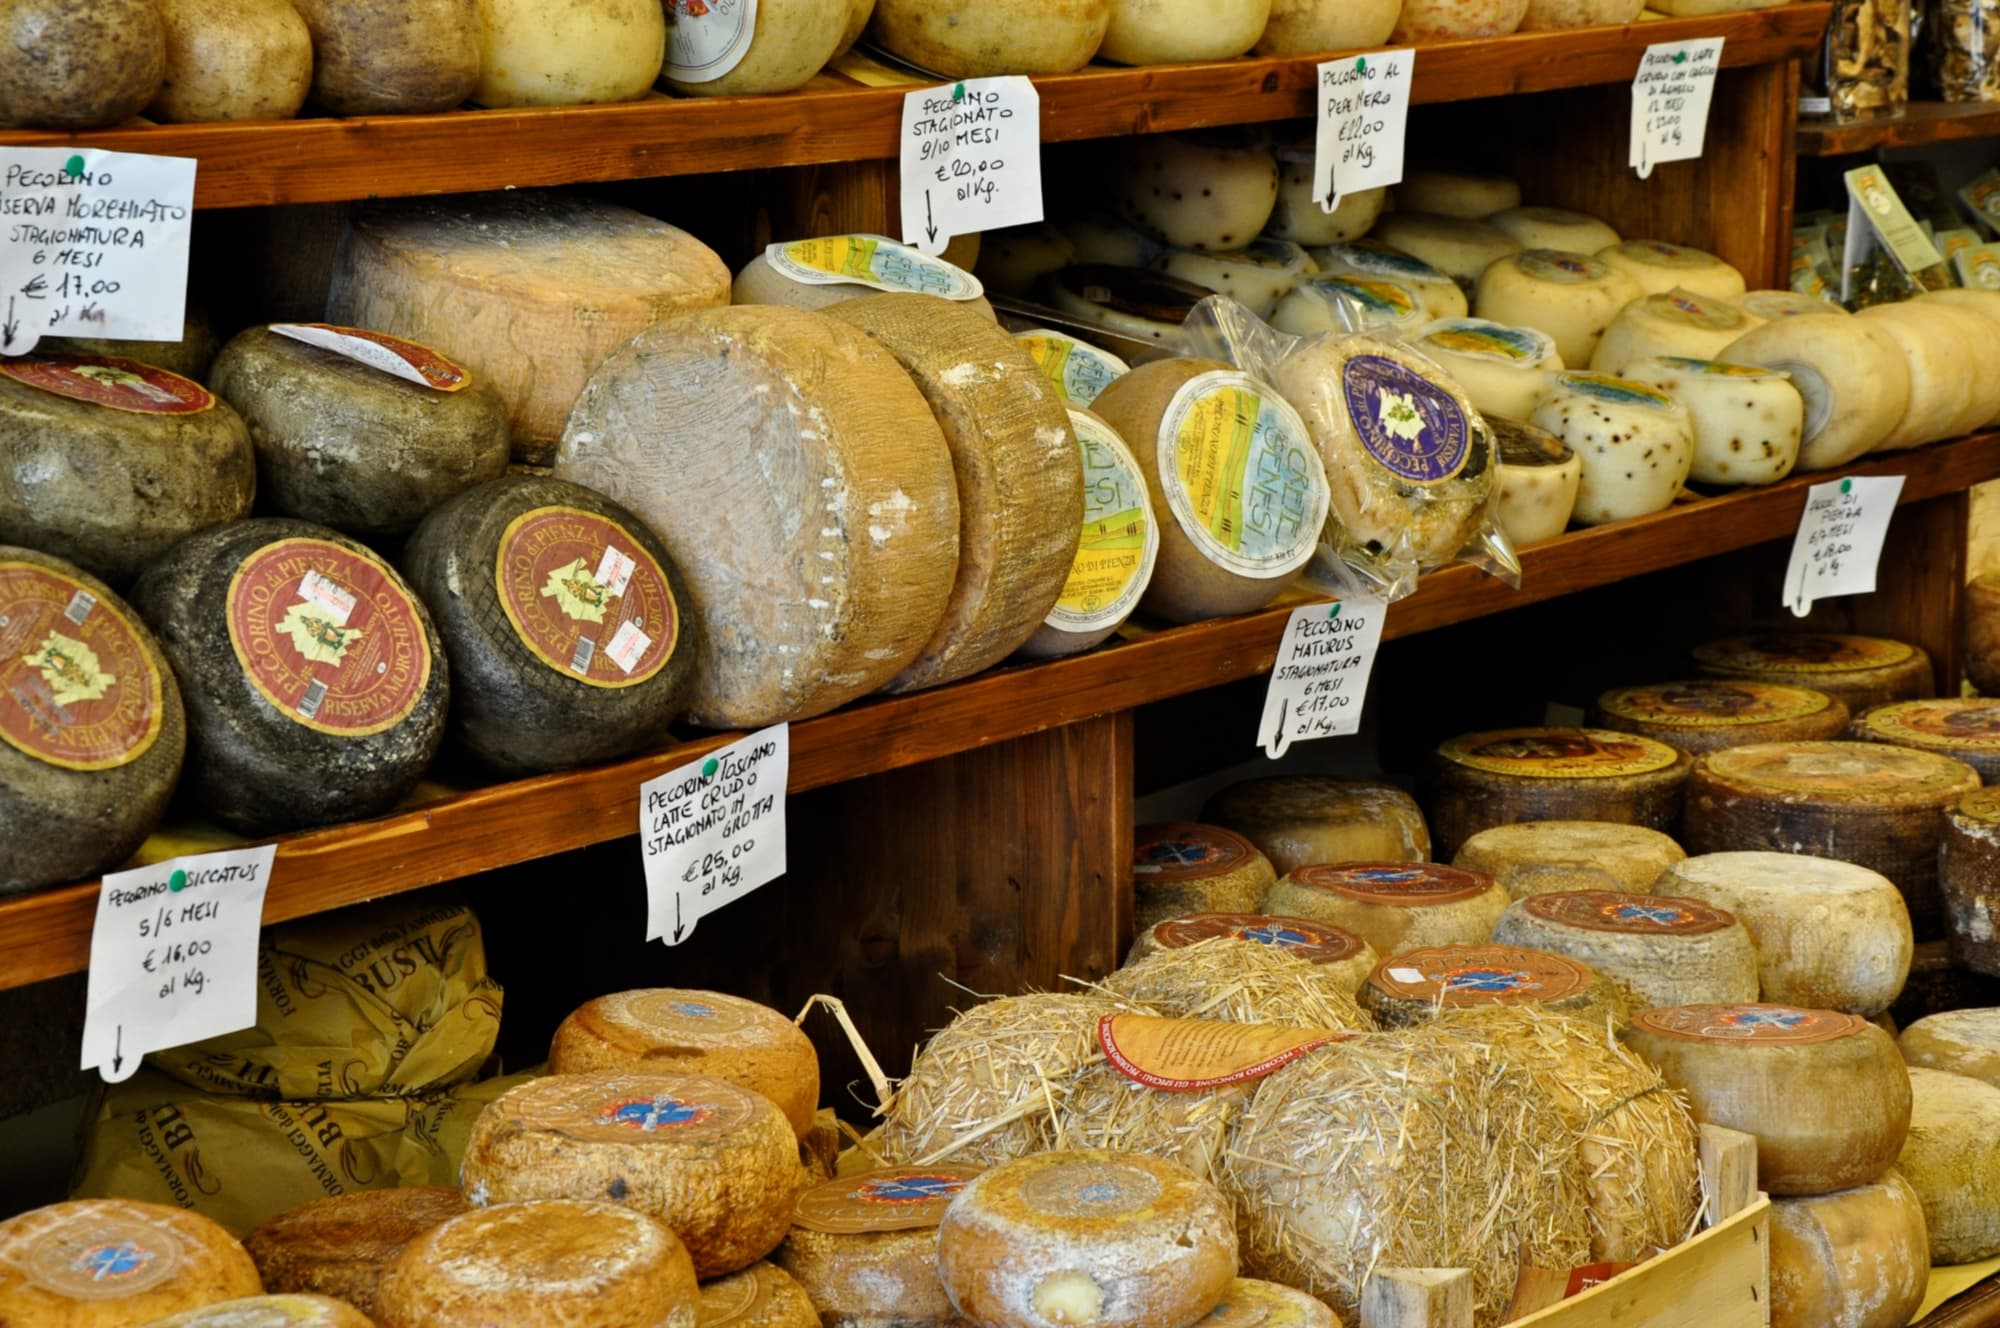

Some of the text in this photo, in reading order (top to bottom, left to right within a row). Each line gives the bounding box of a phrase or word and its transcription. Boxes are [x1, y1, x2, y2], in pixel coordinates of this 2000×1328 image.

[1384, 62, 1401, 79] AL
[1327, 89, 1391, 118] PEPE NERO
[913, 107, 1013, 137] STAGIONATO
[920, 128, 999, 161] 9/10 MESI
[10, 224, 145, 249] STAGIONATURA
[33, 248, 104, 268] 6 MESI
[533, 523, 600, 546] PIENZA
[513, 554, 574, 655] PECORINO
[247, 555, 353, 696] PECORINO di PIENZA
[1294, 617, 1365, 639] PECORINO
[1291, 635, 1355, 661] MATURUS
[1276, 655, 1361, 681] STAGIONATURA
[1304, 677, 1344, 696] 6 MESI
[324, 693, 393, 718] RISERVA
[648, 741, 777, 815] PECORINO TOSCANO
[652, 772, 758, 834] LATTE CRUDO
[647, 794, 745, 857] STAGIONATO IN
[722, 794, 775, 840] GROTTA
[183, 862, 261, 889] SICCATUS
[180, 900, 221, 923] MESI
[1246, 1051, 1294, 1077] PECORINO
[286, 1127, 345, 1198] ORMAGGI
